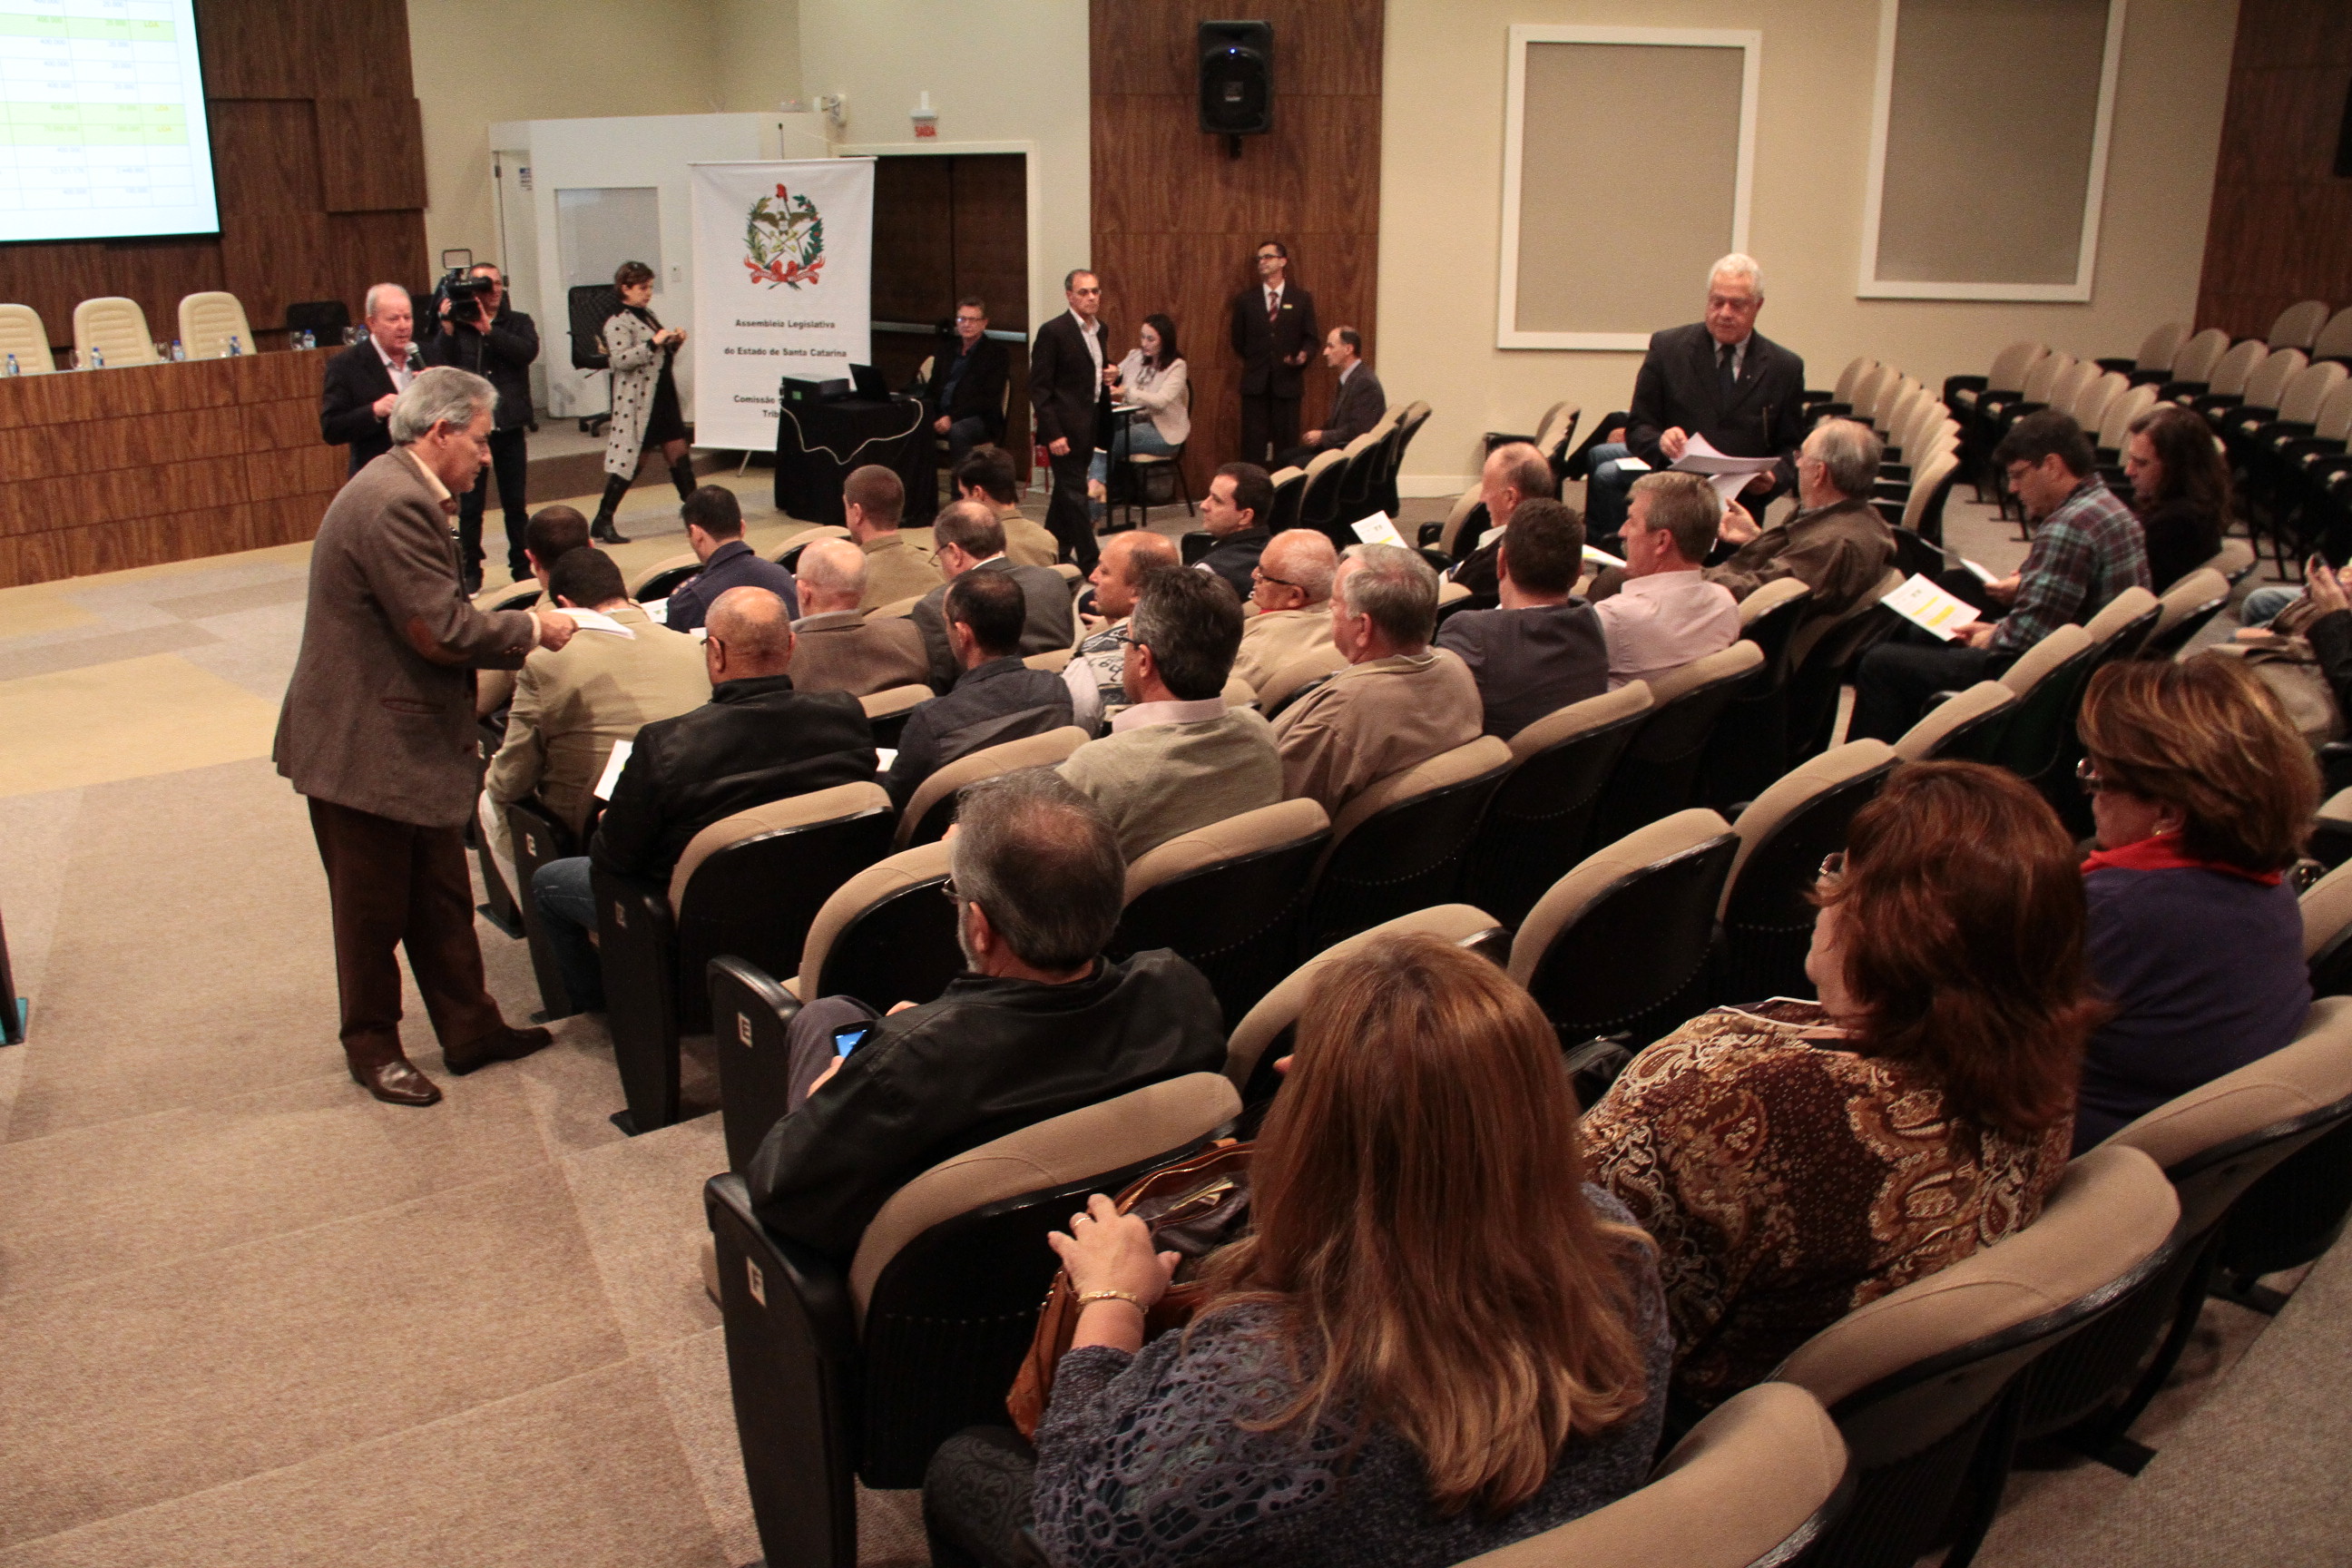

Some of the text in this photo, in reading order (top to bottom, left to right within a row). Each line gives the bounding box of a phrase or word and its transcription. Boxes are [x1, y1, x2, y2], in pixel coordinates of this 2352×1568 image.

[736, 319, 836, 329] Assembleia Legislativa
[734, 395, 776, 404] Comissão
